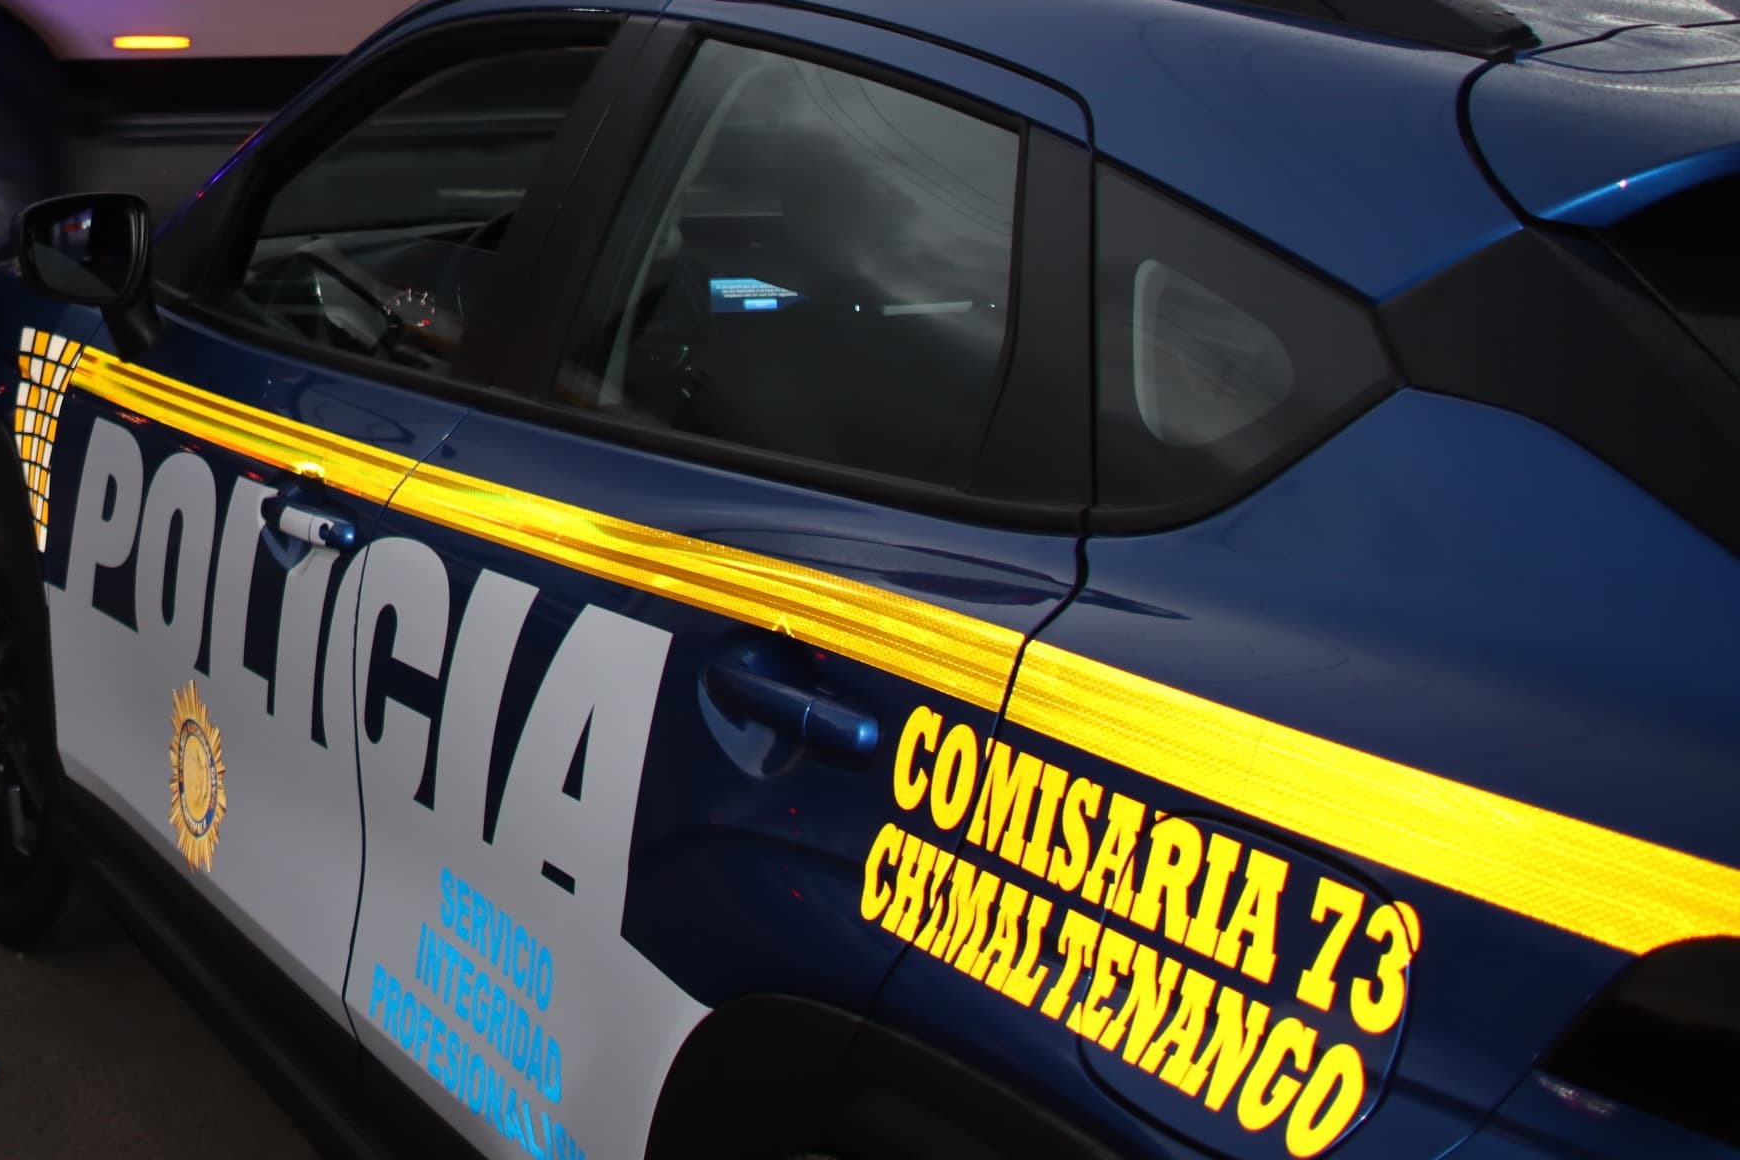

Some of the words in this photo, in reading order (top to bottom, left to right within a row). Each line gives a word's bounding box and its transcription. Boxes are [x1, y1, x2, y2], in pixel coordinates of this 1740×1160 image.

[65, 417, 674, 937] POLICIA
[416, 922, 561, 1105] INTEGRIDAD
[439, 867, 553, 1012] SERVICIO
[860, 822, 1365, 1158] CHIMALTENANGO
[893, 706, 1289, 984] COMISARIA
[1296, 876, 1420, 1034] 73
